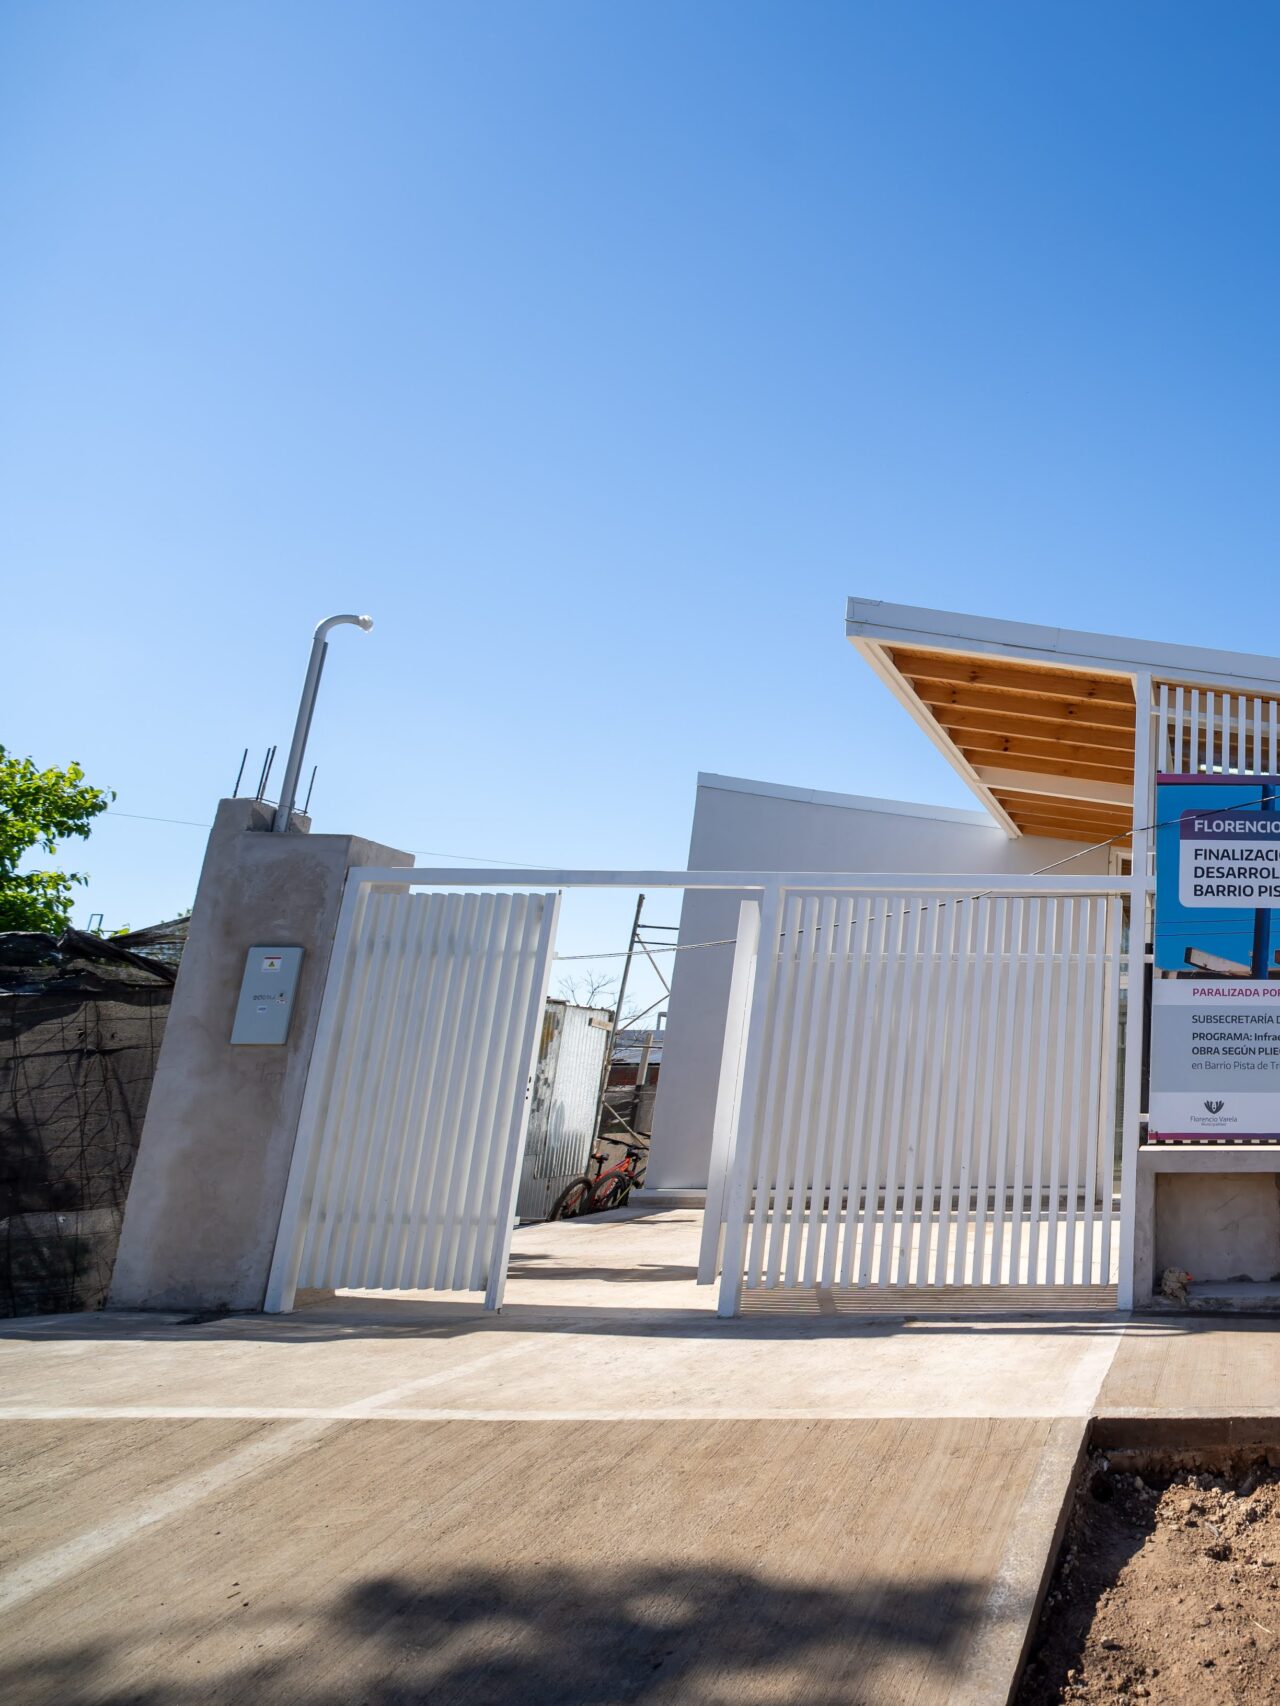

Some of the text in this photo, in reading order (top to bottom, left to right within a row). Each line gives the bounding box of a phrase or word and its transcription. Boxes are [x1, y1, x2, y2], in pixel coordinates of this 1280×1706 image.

[1194, 884, 1254, 897] BARRIO
[1192, 988, 1260, 997] PARALIZADA
[1192, 1013, 1274, 1024] SUBSECRETARÍA
[1192, 1033, 1252, 1041] PROGRAMA:
[1192, 1047, 1220, 1055] OBRA
[1222, 1045, 1256, 1055] SEGÚN
[1205, 1061, 1231, 1070] Barrio
[1234, 1061, 1255, 1070] Pista
[1257, 1061, 1268, 1070] de
